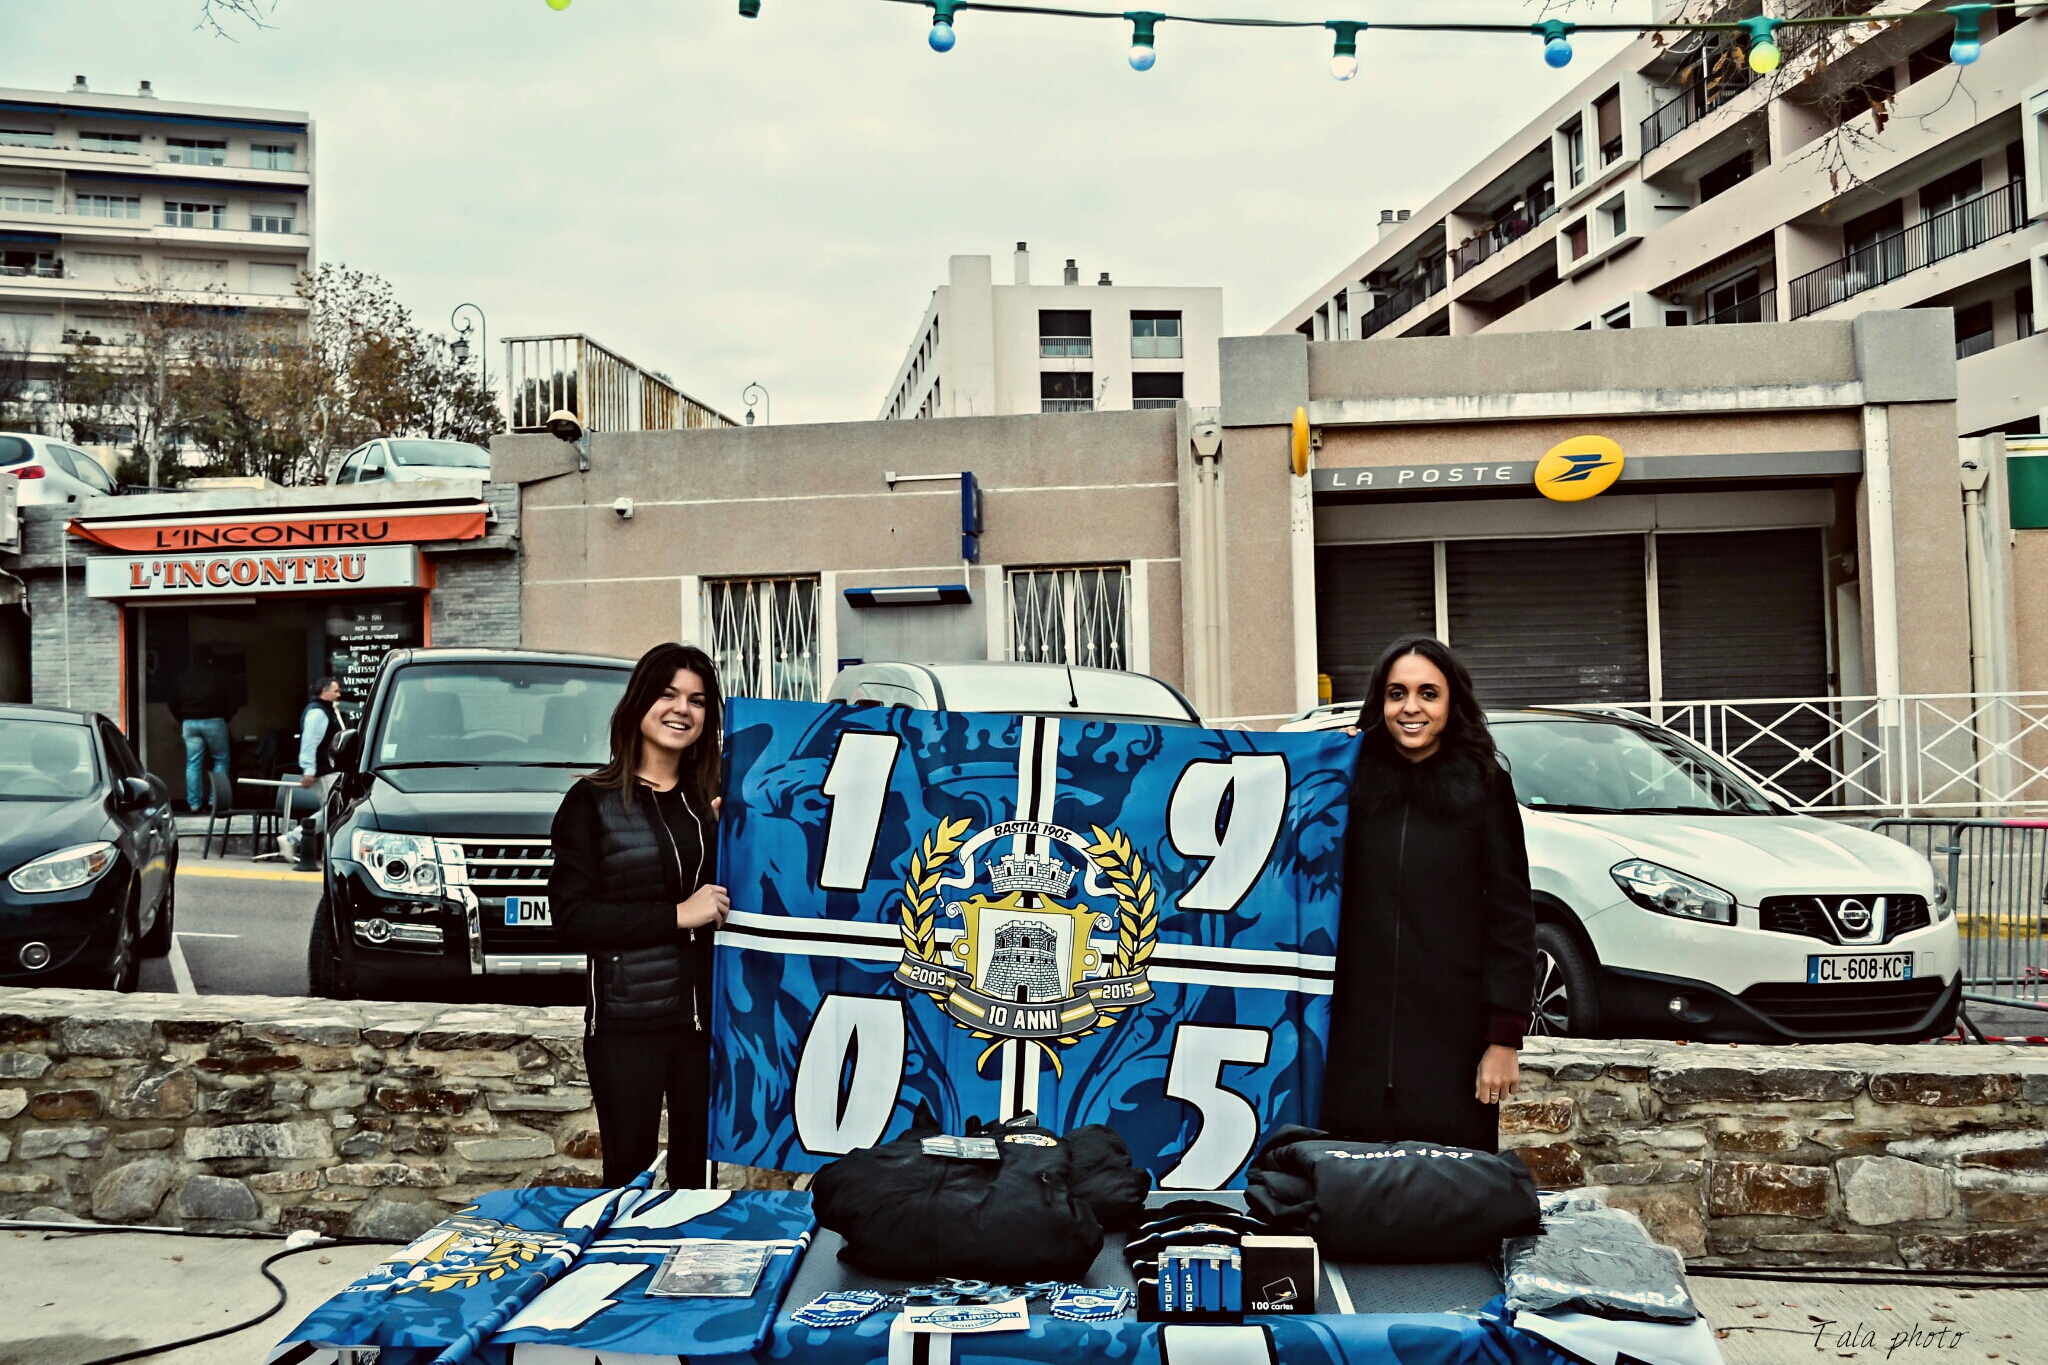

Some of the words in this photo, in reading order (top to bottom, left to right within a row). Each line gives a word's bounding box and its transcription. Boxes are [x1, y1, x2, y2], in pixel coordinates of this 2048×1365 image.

[1332, 472, 1374, 487] LA
[1398, 466, 1513, 484] POSTE
[156, 521, 389, 548] L'INCONTRU
[130, 554, 366, 590] L'INCONTRU
[817, 730, 902, 892] 1
[1167, 753, 1290, 913] 9
[994, 822, 1040, 837] BASTIA
[1042, 824, 1073, 842] 1905
[909, 964, 946, 986] 2005
[1820, 957, 1902, 981] CL-608-KC
[1102, 982, 1134, 1000] 2015
[988, 1005, 1008, 1027] 10
[1013, 1008, 1058, 1030] ANNI
[1251, 1301, 1269, 1311] 100
[1271, 1301, 1294, 1311] cartes
